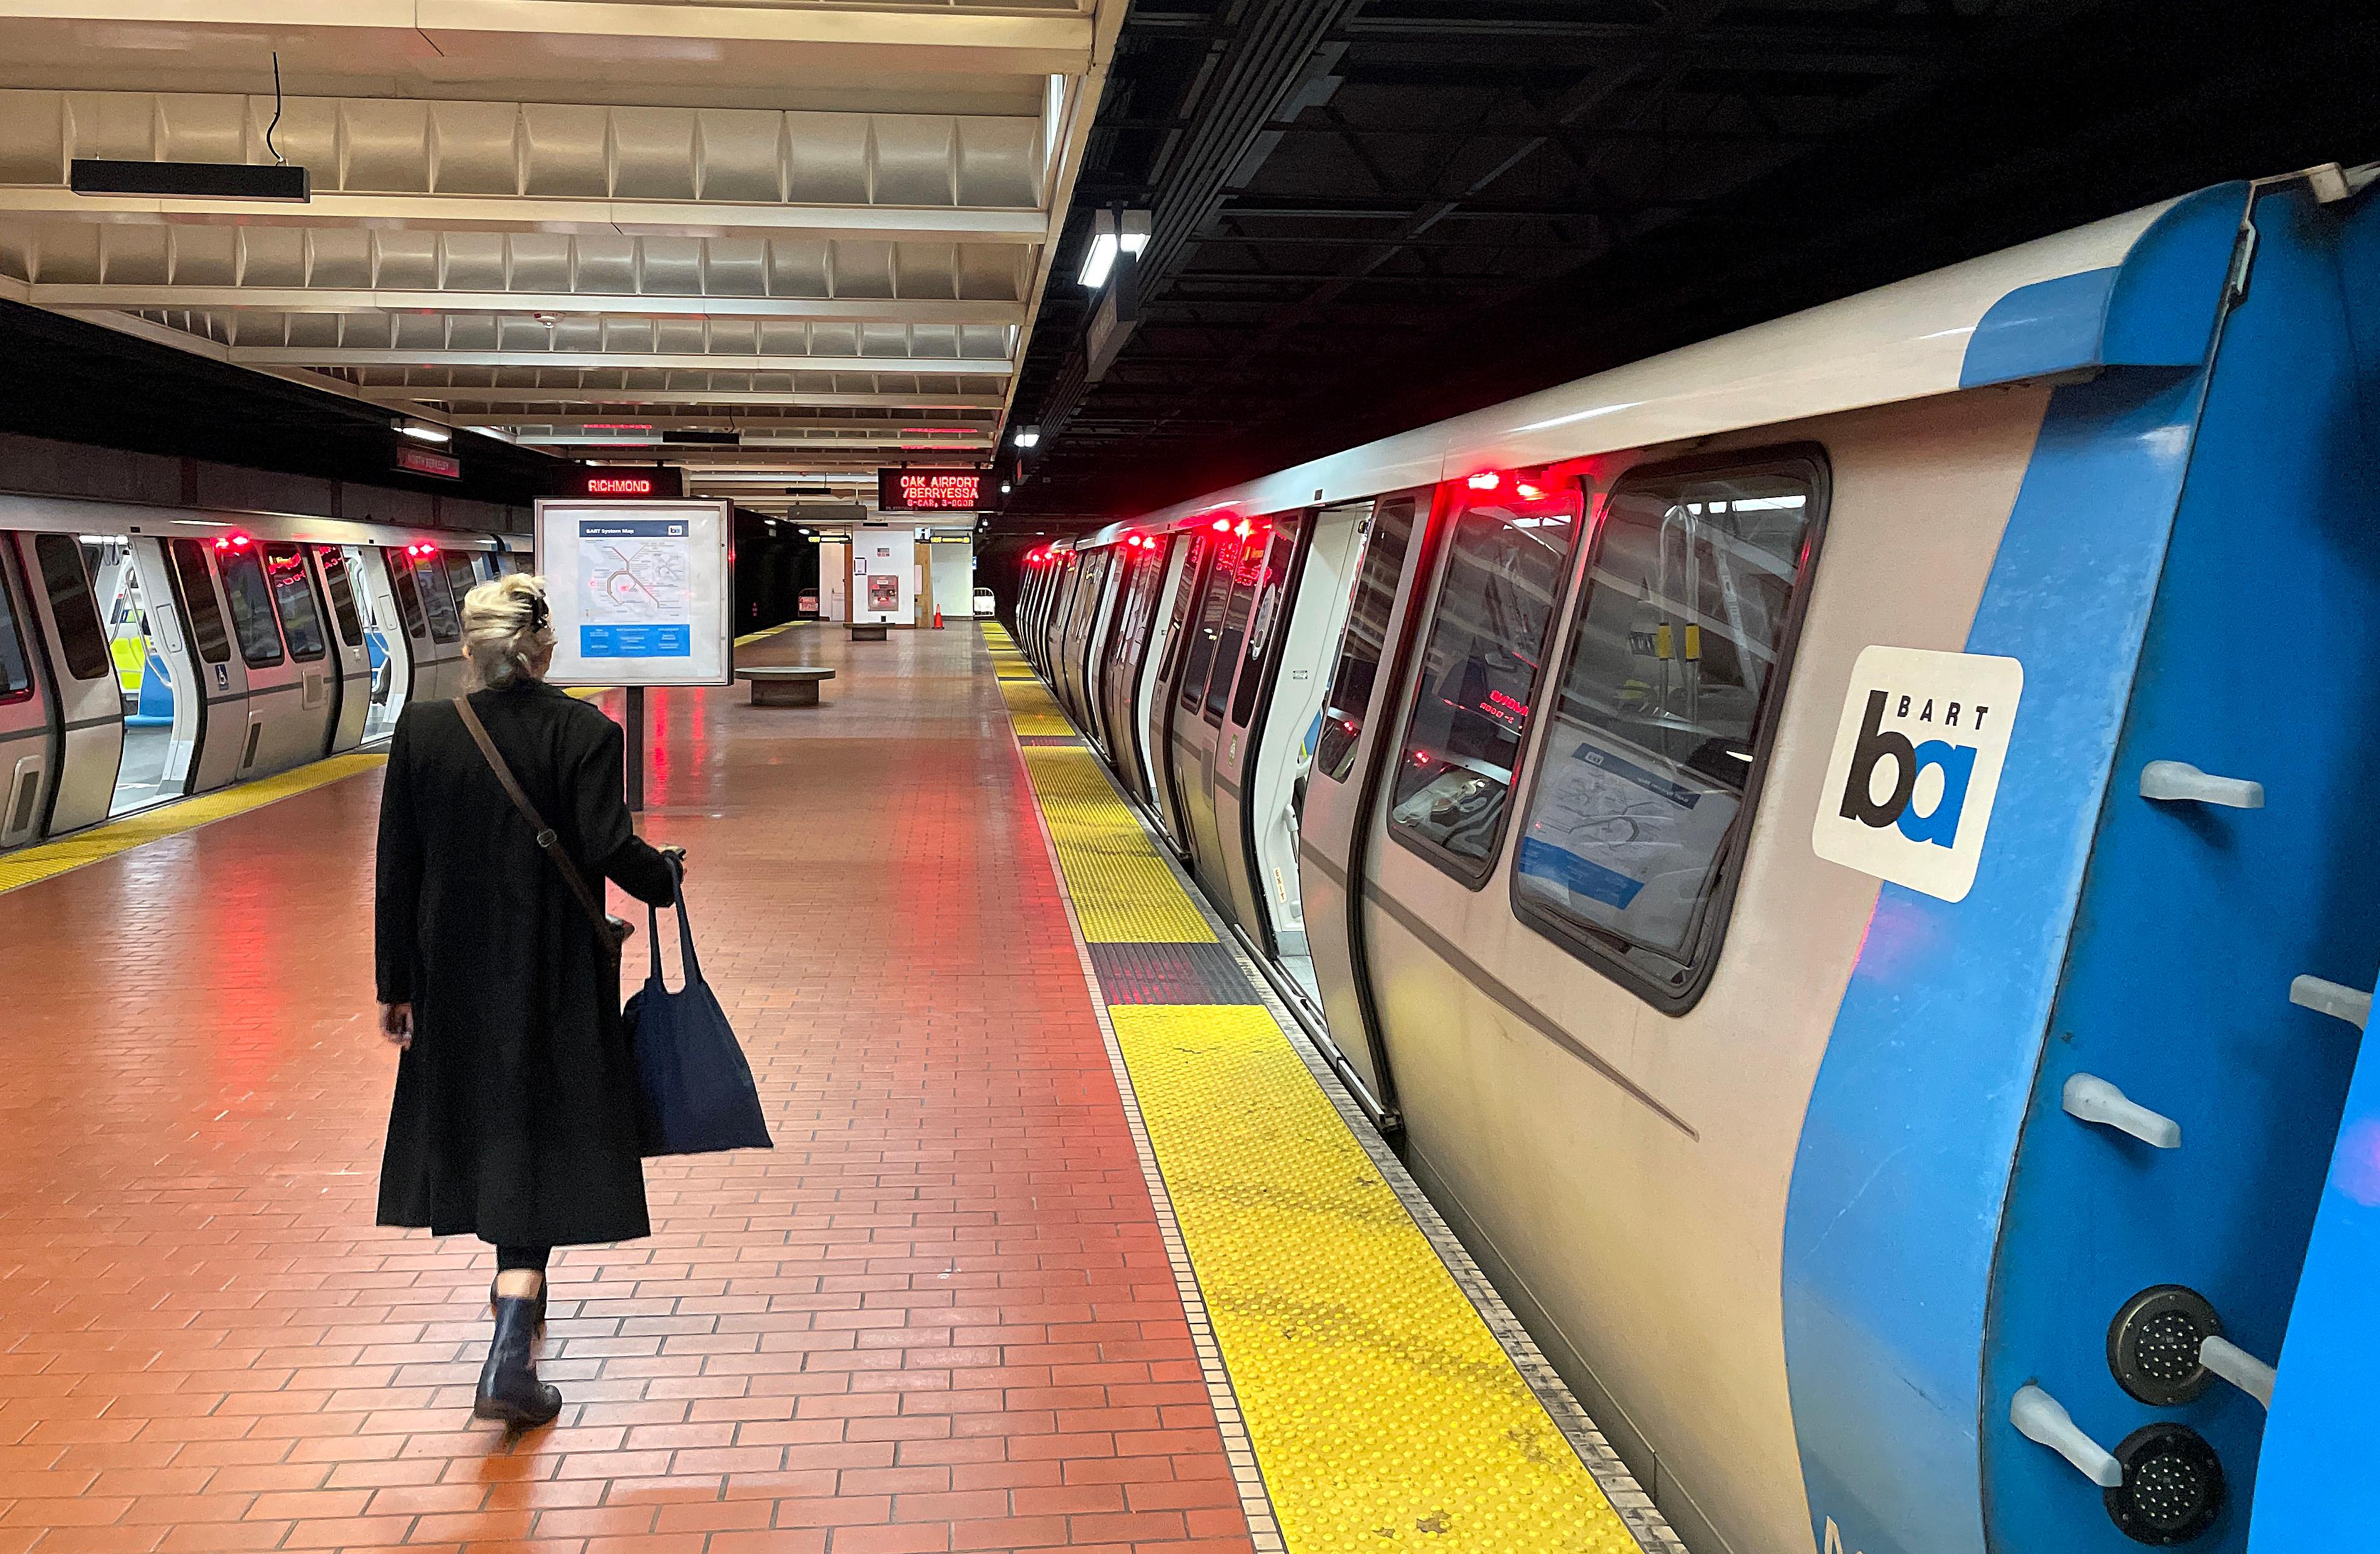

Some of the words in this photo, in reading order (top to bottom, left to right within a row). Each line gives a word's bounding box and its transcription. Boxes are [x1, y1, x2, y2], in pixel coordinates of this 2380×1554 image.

[588, 480, 650, 492] RICHMOND
[900, 475, 925, 488] OAK
[930, 476, 980, 488] AIRPORT
[903, 487, 979, 499] /BERRYESSA
[1897, 695, 1989, 731] BART
[1838, 689, 1978, 850] ba
[1275, 869, 1284, 900] EXIT
